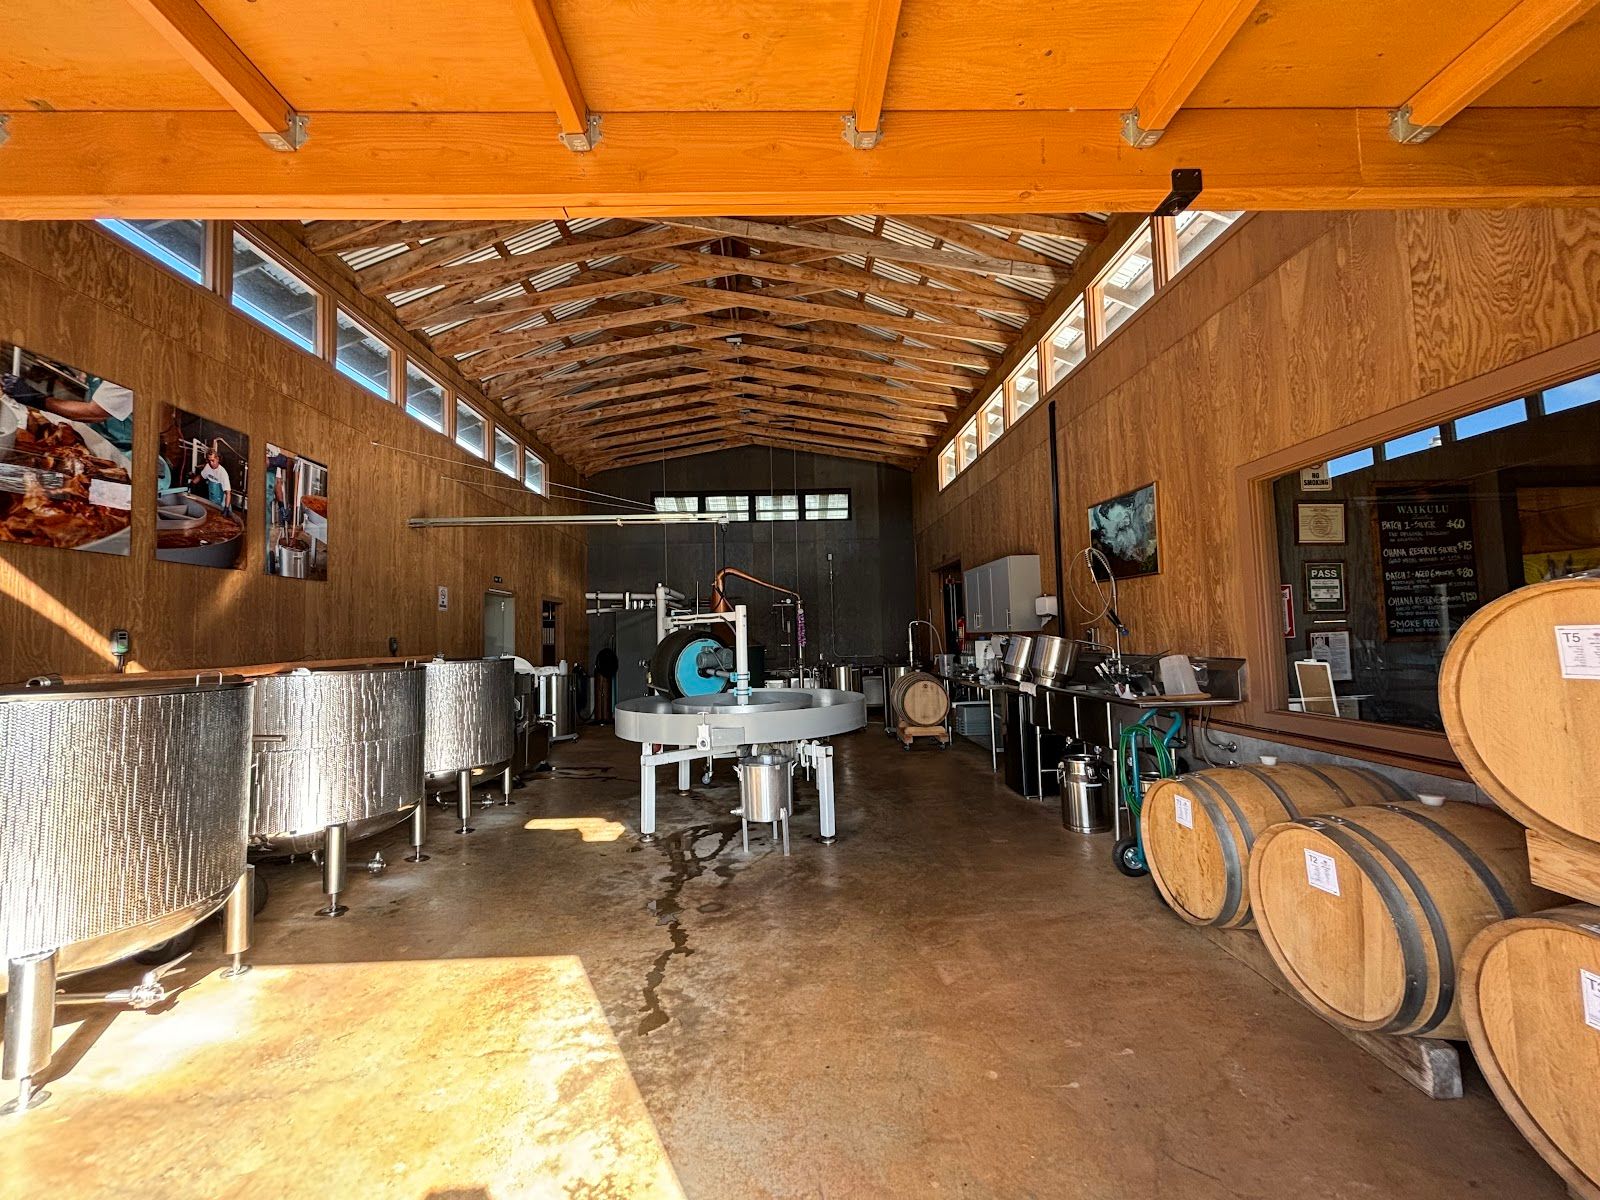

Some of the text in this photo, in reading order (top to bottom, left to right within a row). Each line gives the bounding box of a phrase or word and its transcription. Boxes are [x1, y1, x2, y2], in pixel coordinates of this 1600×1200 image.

[1396, 504, 1449, 514] WAIKULU
[1381, 520, 1402, 530] BATCH
[1446, 518, 1465, 529] $60
[1383, 540, 1473, 557] OHANA RESERVE SILVER $75
[1311, 569, 1338, 578] PASS
[1385, 571, 1406, 581] BATCH
[1456, 567, 1474, 578] $80
[1390, 618, 1420, 628] SMOKE
[1562, 632, 1581, 643] T5
[1308, 854, 1318, 864] T2
